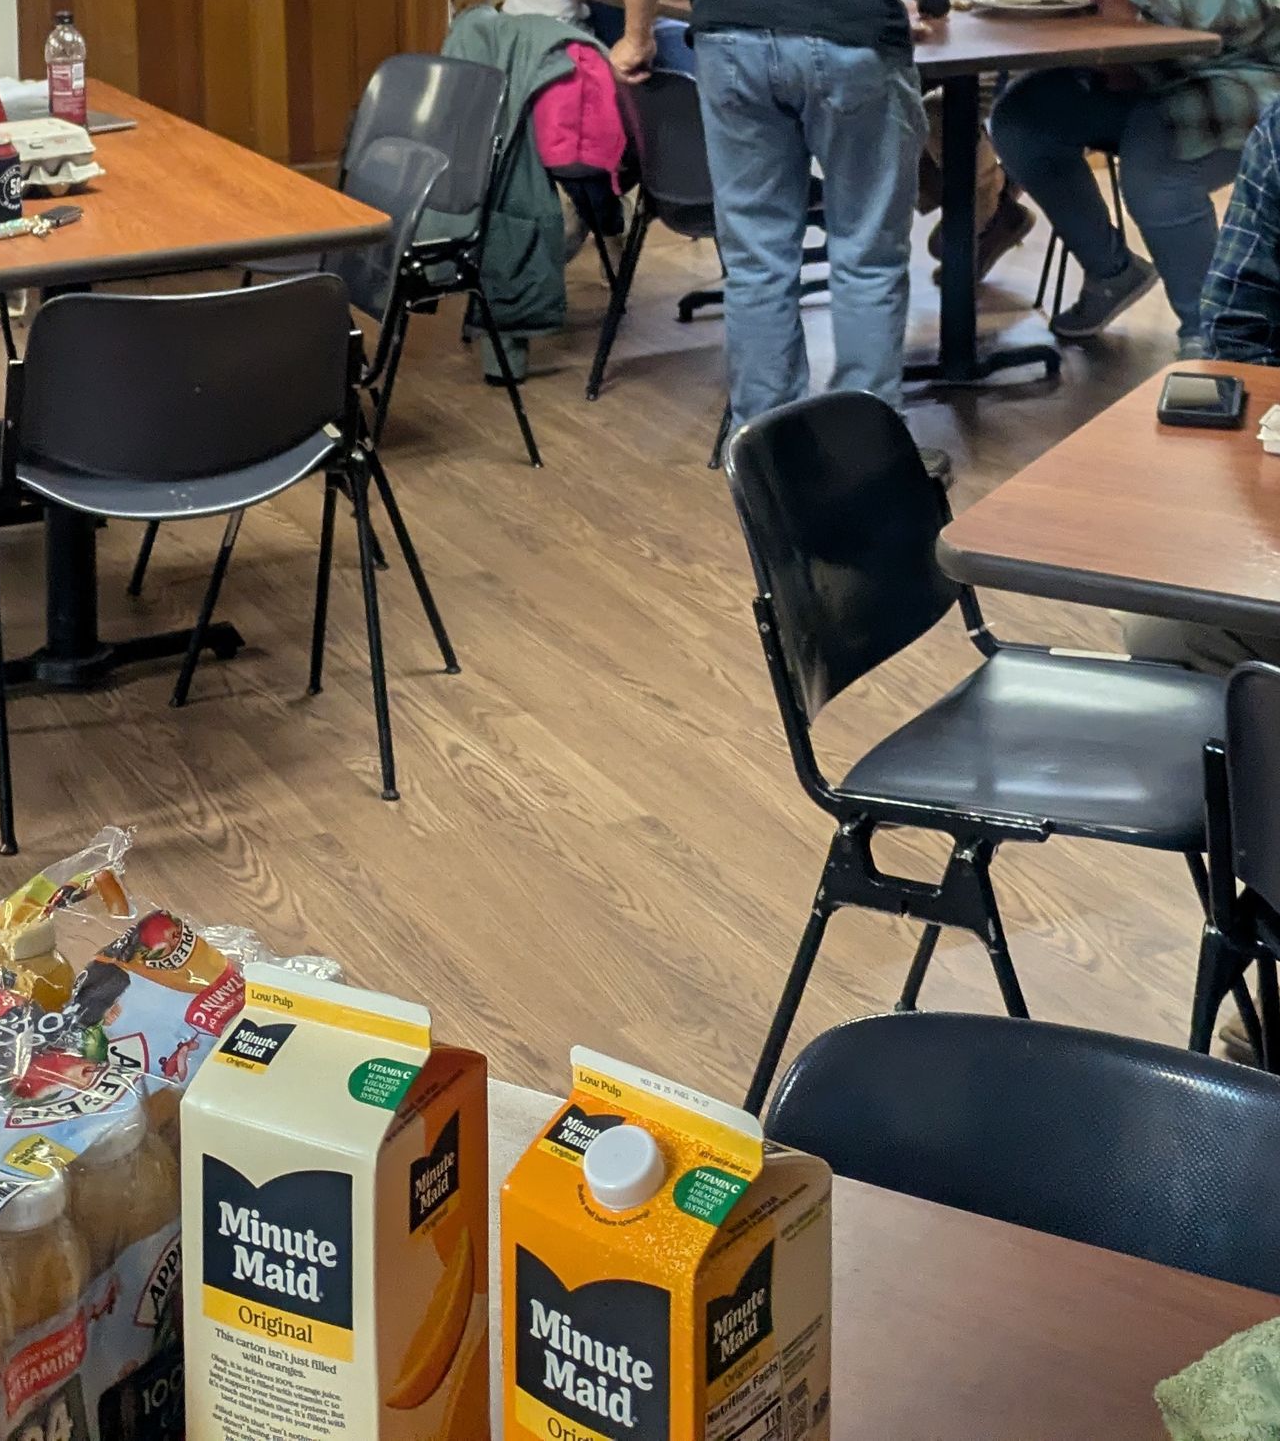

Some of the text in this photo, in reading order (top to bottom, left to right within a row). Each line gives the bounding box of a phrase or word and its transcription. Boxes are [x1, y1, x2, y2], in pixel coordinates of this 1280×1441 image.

[251, 989, 271, 1002] Low
[272, 994, 294, 1010] Pulp
[233, 1041, 267, 1058] Maid
[235, 1029, 278, 1049] Minute
[226, 1056, 255, 1071] Original
[368, 1063, 412, 1080] VITAMIN C
[579, 1071, 622, 1099] Low Pulp
[562, 1116, 601, 1140] Minut
[415, 1151, 456, 1199] Minute
[419, 1172, 449, 1215] Maid
[695, 1169, 741, 1194] VITAMIN C
[218, 1200, 337, 1268] Minute
[232, 1244, 321, 1303] Maid
[238, 1305, 313, 1344] Original
[713, 1287, 766, 1345] Minute
[215, 1328, 234, 1343] This
[236, 1338, 266, 1355] carton
[289, 1353, 309, 1368] just
[311, 1360, 337, 1375] filled
[529, 1298, 653, 1391] Minute
[720, 1312, 758, 1363] Maid
[242, 1352, 306, 1379] with oranges.
[543, 1350, 634, 1428] Maid
